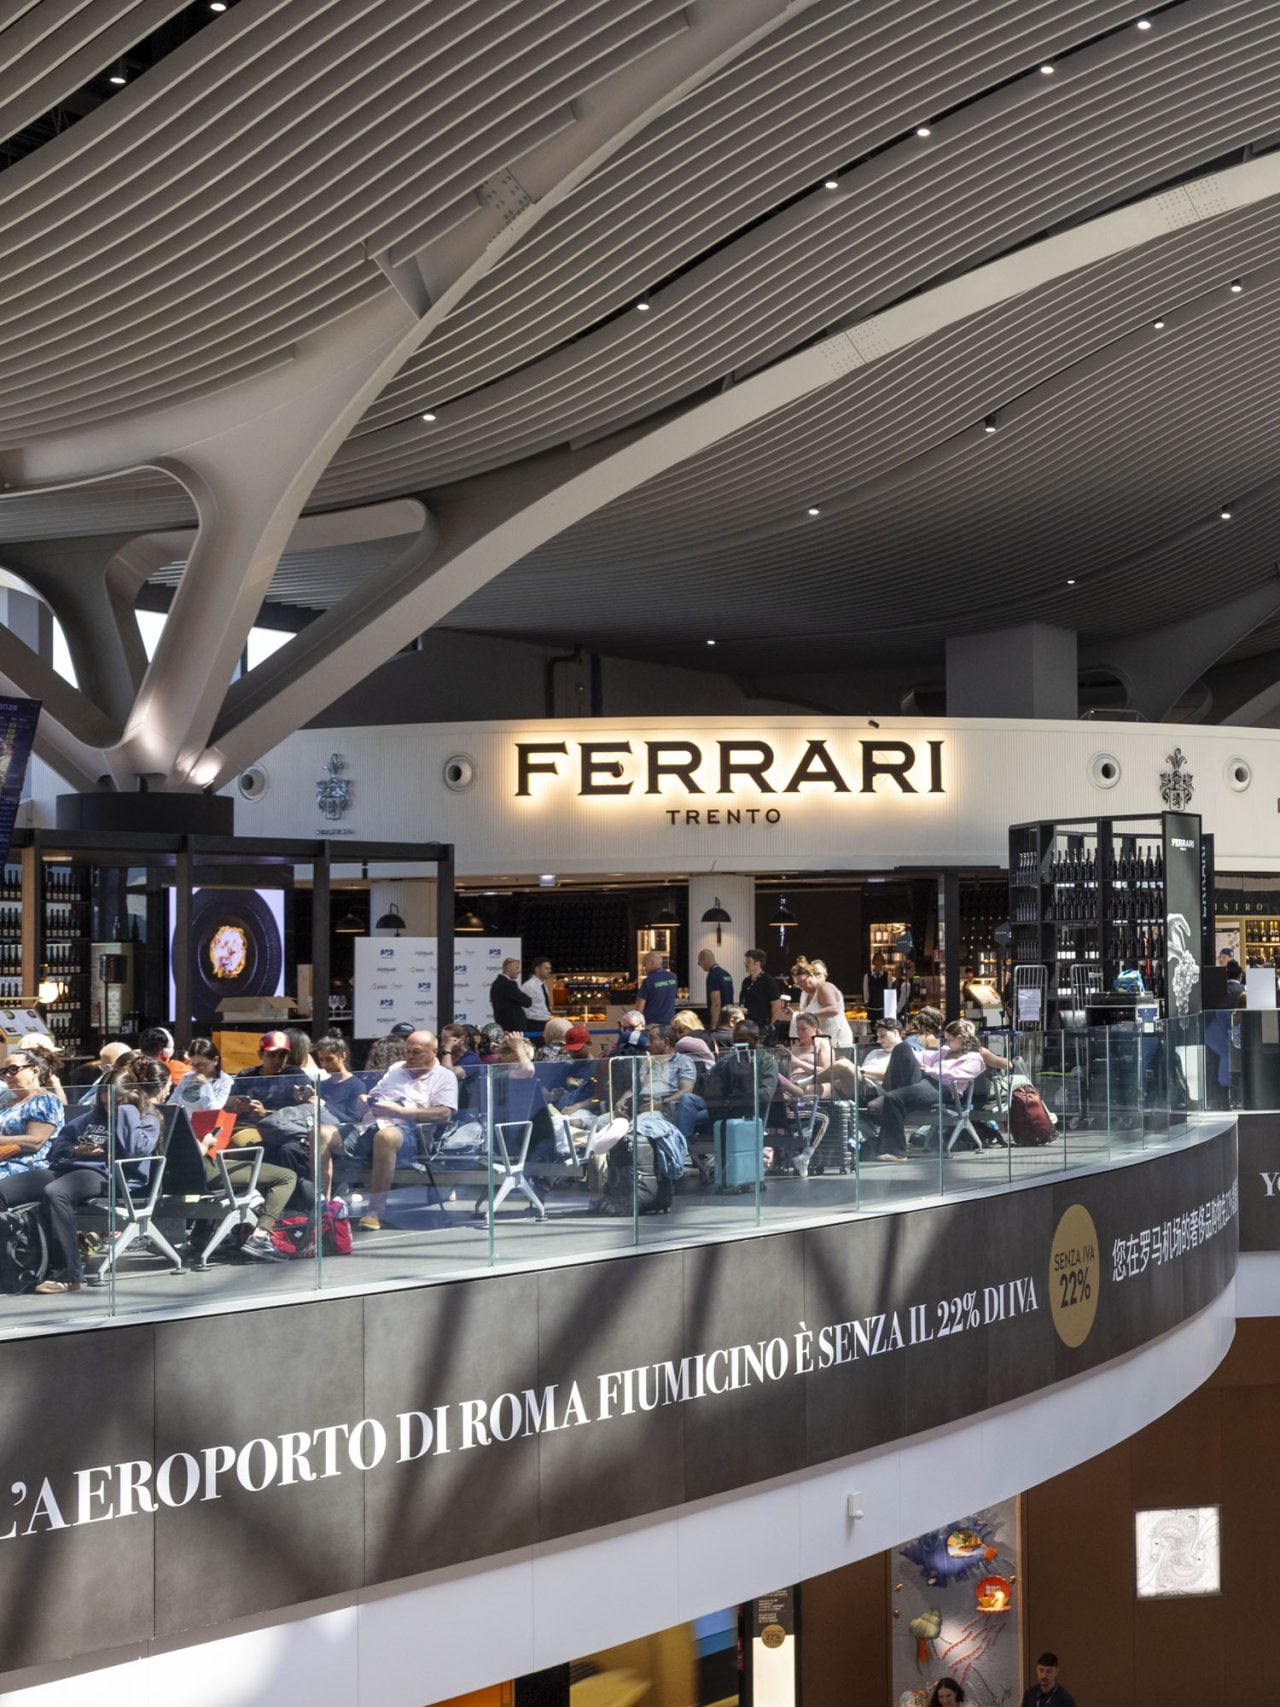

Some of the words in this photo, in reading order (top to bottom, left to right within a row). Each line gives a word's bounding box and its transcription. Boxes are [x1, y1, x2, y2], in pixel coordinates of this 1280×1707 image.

[514, 739, 946, 796] FERRARI
[666, 808, 781, 825] TRENTO
[1214, 902, 1264, 912] ISTRO
[1054, 1249, 1081, 1272] SENZA
[1083, 1244, 1096, 1262] IVA
[1059, 1267, 1091, 1309] 22%
[396, 1405, 451, 1463] DI
[459, 1380, 591, 1450] ROMA
[597, 1337, 789, 1421] FIUMICINO
[794, 1322, 814, 1375] È
[818, 1311, 905, 1370] SENZA
[909, 1304, 934, 1345] IL
[937, 1291, 980, 1338] 22%
[983, 1285, 1006, 1324] DI
[1008, 1276, 1039, 1318] IVA
